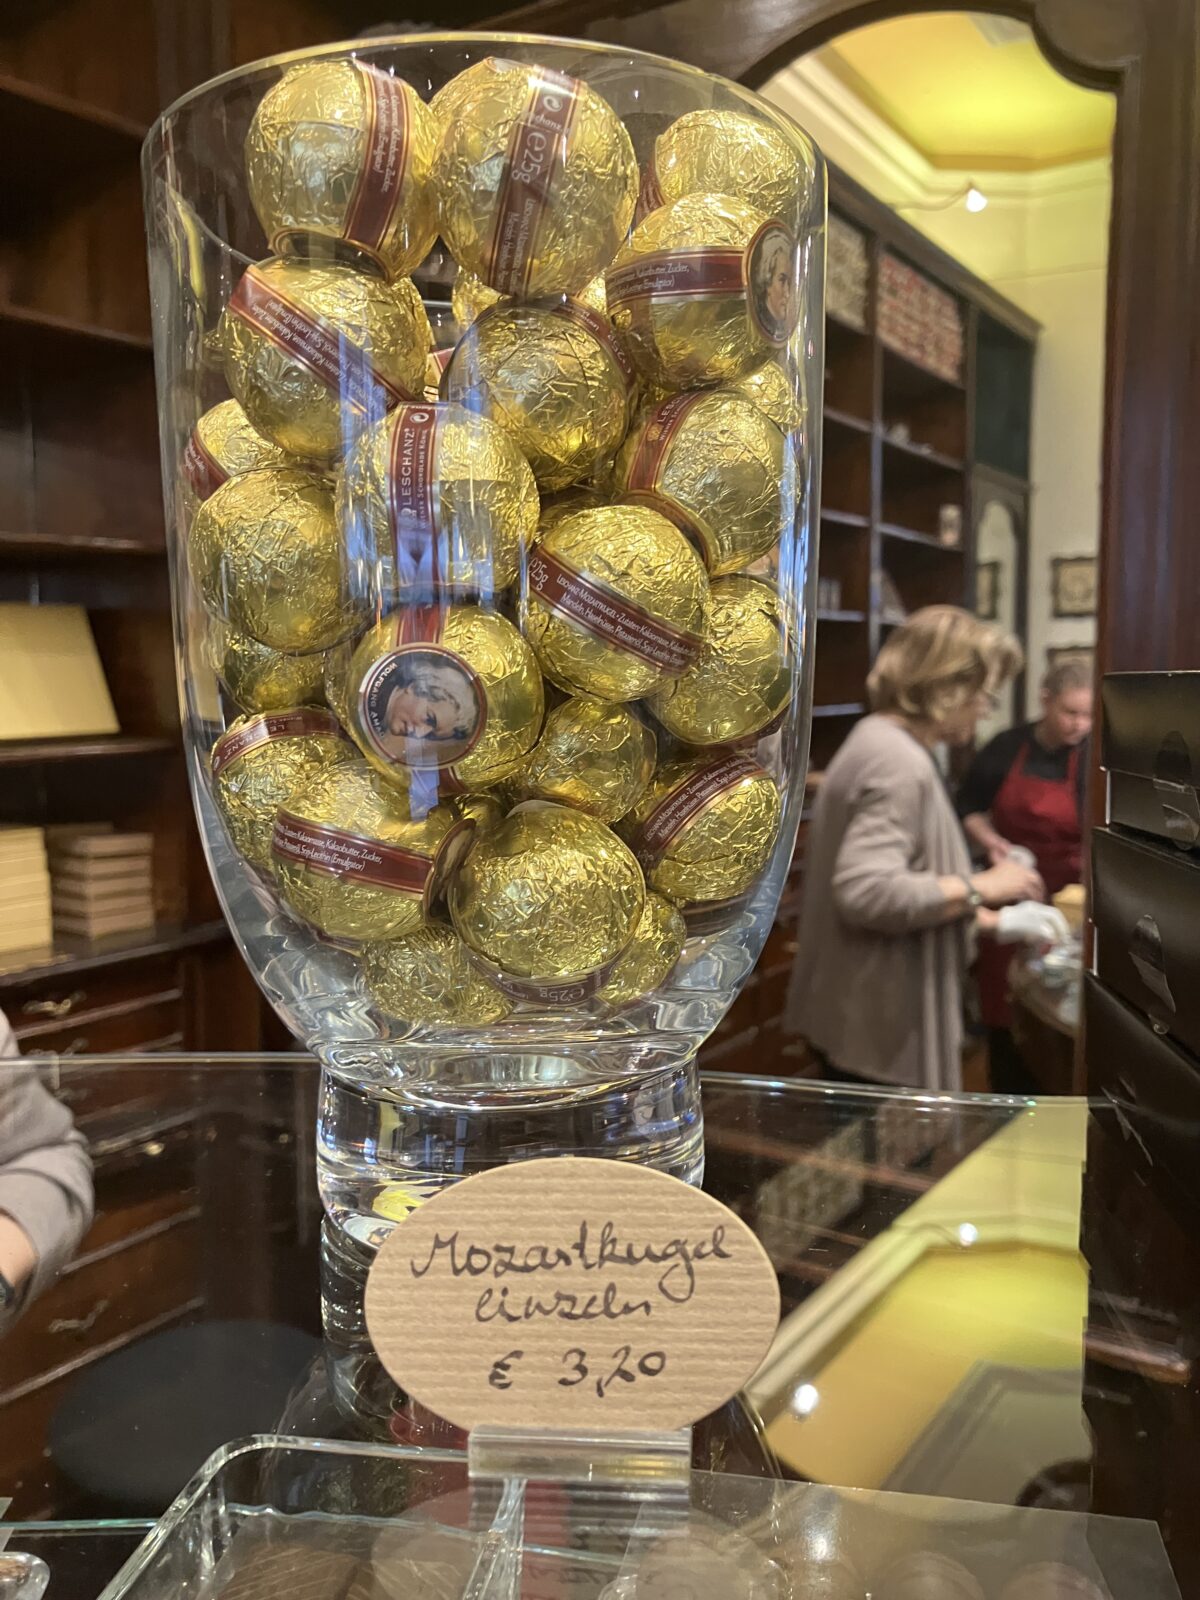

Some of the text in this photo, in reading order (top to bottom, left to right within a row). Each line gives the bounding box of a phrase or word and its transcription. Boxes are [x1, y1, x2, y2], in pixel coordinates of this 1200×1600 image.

[410, 1220, 733, 1303] Mozartkugel
[475, 1282, 650, 1322] einzeln
[488, 1345, 666, 1397] € 3,20
